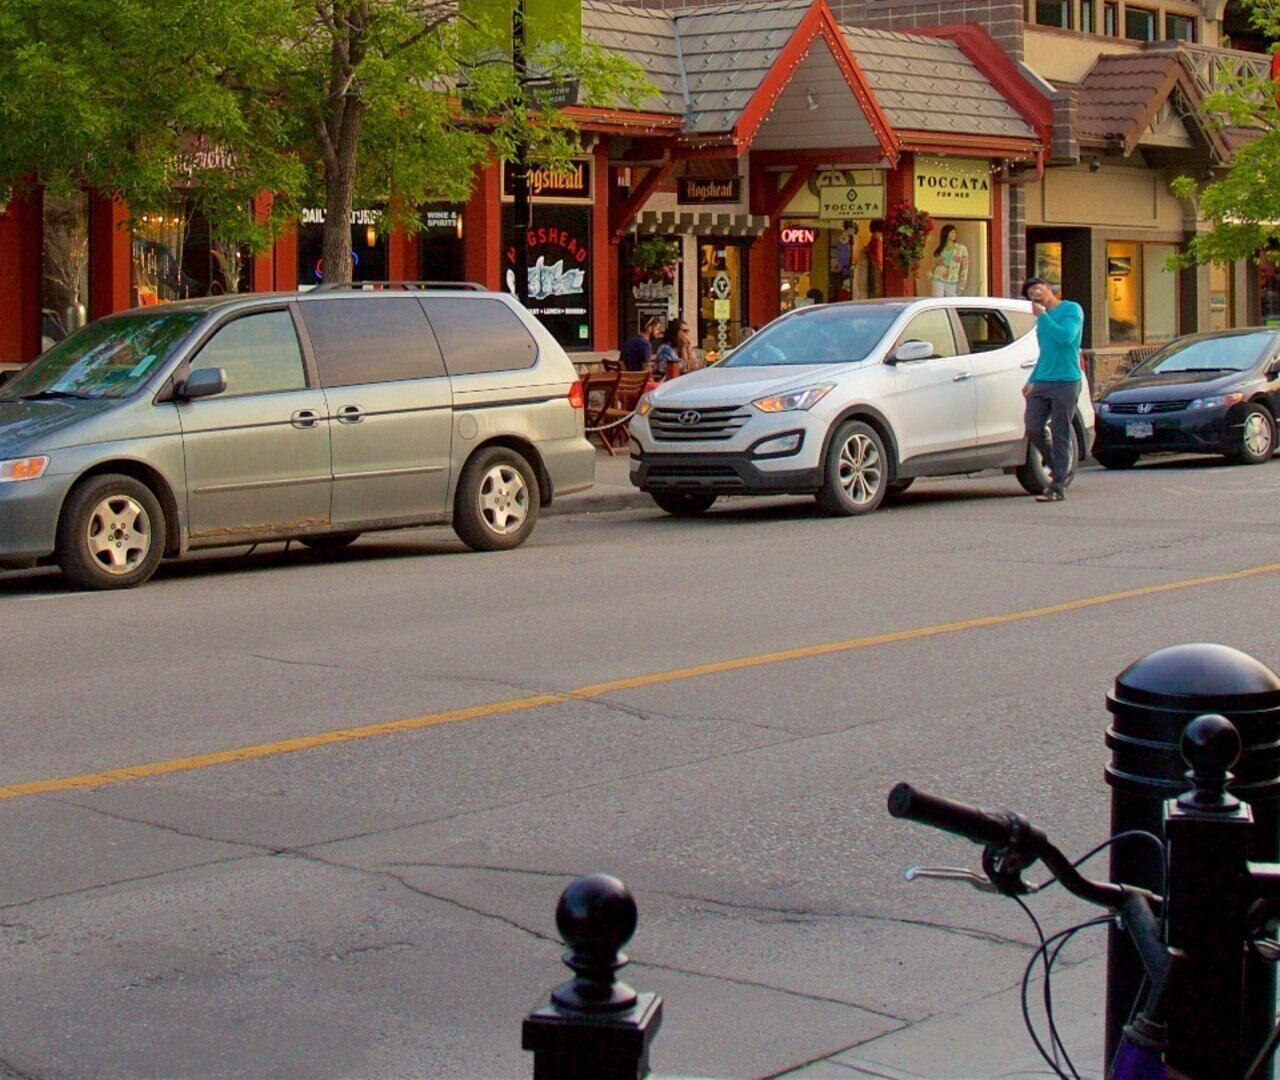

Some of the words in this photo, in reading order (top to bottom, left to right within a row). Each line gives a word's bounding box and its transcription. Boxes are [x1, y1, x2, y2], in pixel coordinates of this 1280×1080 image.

[526, 163, 584, 194] ogshead
[916, 174, 989, 191] TOCCATA
[687, 181, 733, 201] Hogshead
[301, 207, 328, 224] DAIL
[823, 203, 879, 212] TOCCATA
[781, 229, 815, 243] OPEN
